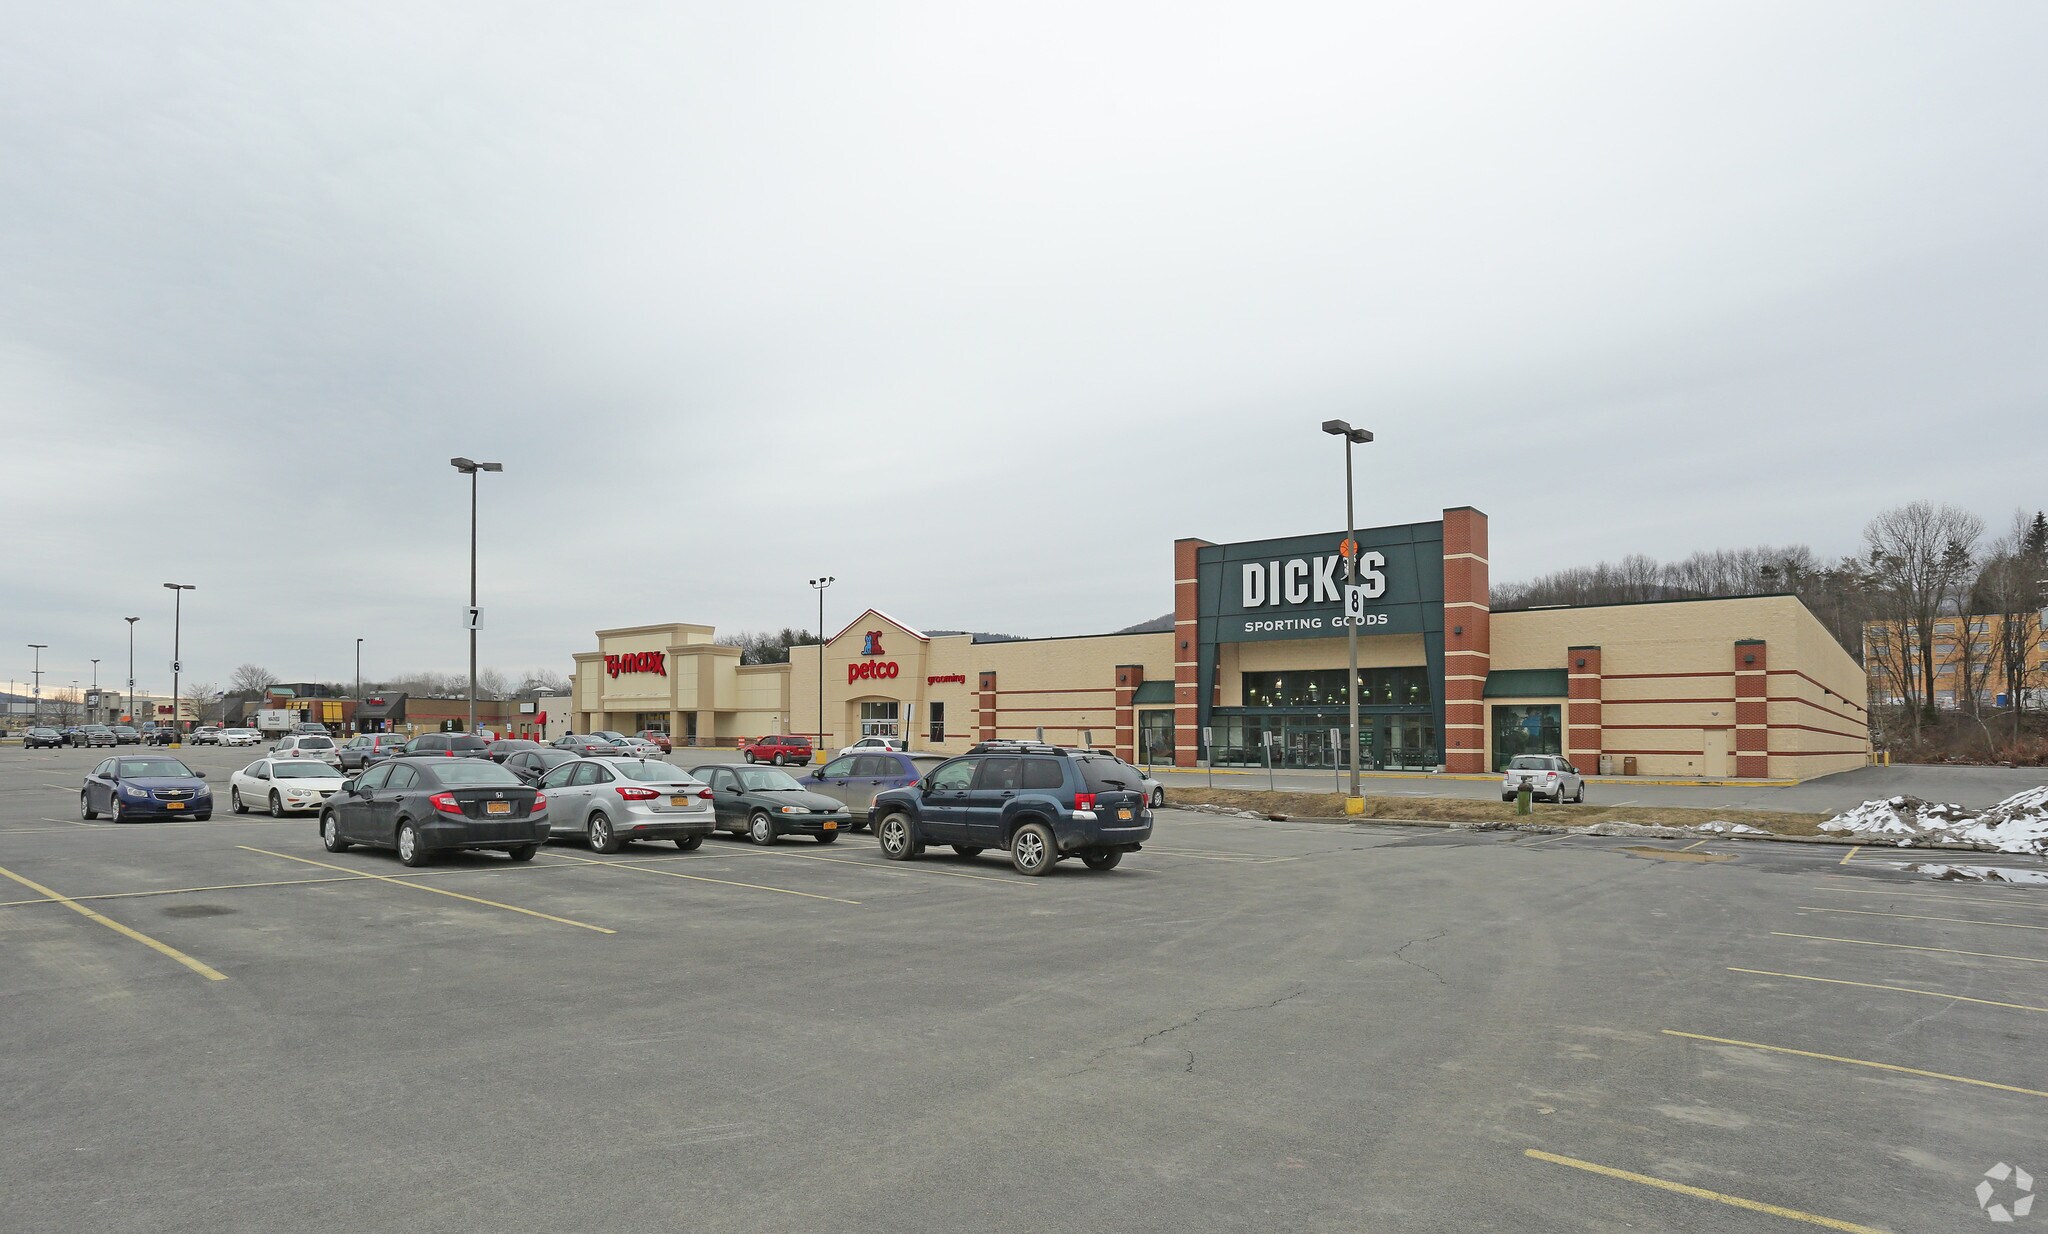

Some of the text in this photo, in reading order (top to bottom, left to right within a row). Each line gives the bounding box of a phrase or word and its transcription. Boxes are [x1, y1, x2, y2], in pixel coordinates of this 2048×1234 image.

[1351, 589, 1359, 613] 8
[469, 609, 479, 626] 7
[1244, 613, 1388, 632] SPORTING GOODS
[173, 662, 180, 672] 6
[848, 659, 899, 685] petco
[129, 679, 134, 687] 5
[927, 673, 966, 686] grooming
